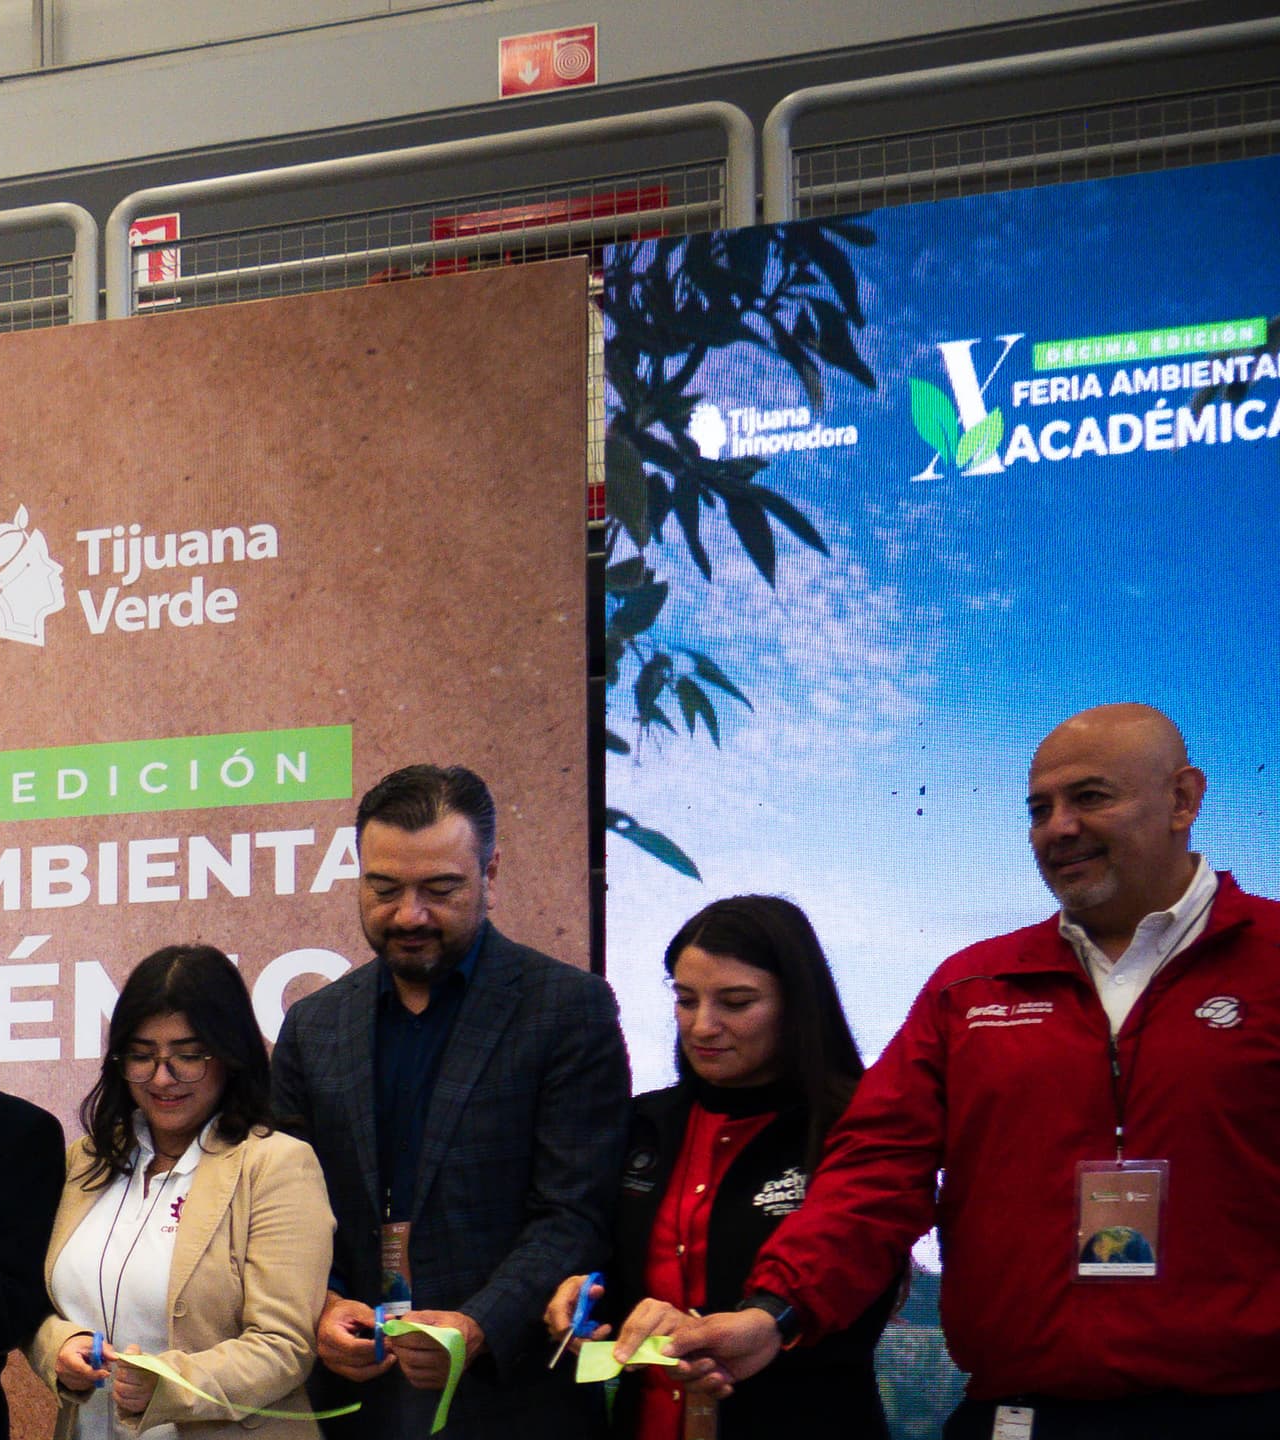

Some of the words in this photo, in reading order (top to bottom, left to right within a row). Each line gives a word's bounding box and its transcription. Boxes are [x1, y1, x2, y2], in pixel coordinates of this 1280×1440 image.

[1151, 326, 1254, 351] EDICIÓN
[1013, 373, 1103, 407] FERIA
[1109, 353, 1280, 397] AMBIENTA
[728, 406, 810, 438] Tijuana
[732, 423, 858, 457] Innovadora
[77, 523, 278, 586] Tijuana
[78, 576, 238, 636] Verde
[12, 748, 307, 804] EDICIÓN
